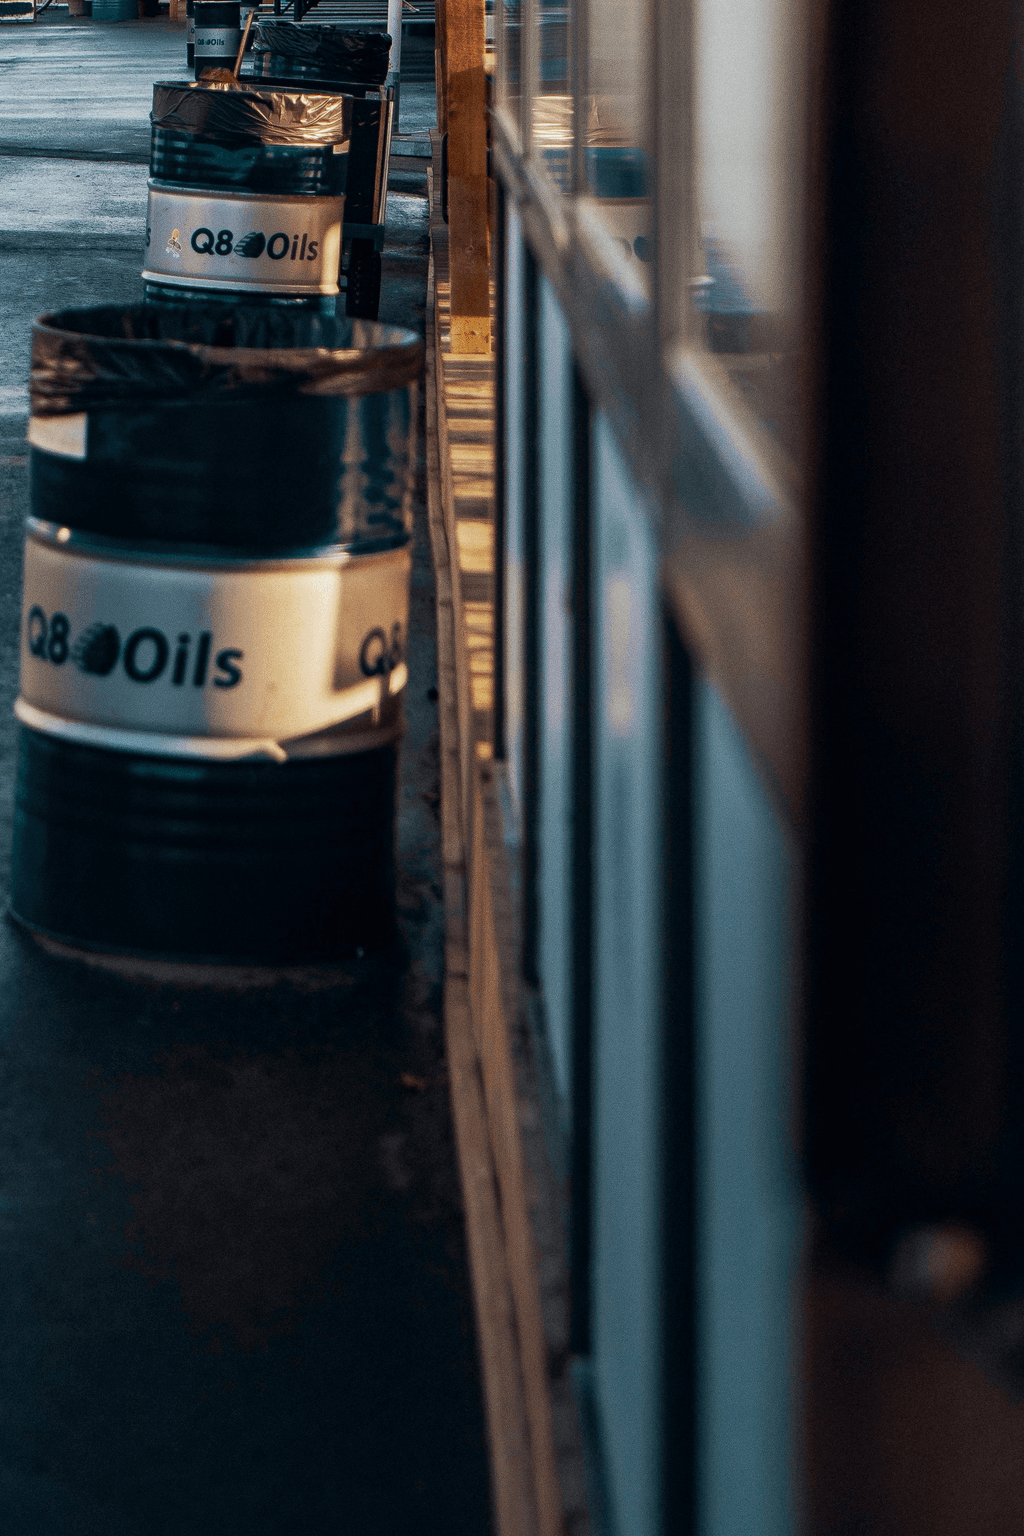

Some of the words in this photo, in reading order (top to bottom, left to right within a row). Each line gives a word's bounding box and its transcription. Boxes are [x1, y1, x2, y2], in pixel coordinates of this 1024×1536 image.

[191, 227, 234, 256] Q8
[266, 232, 319, 261] Oils
[28, 604, 71, 666] Q8
[123, 626, 244, 690] Oils
